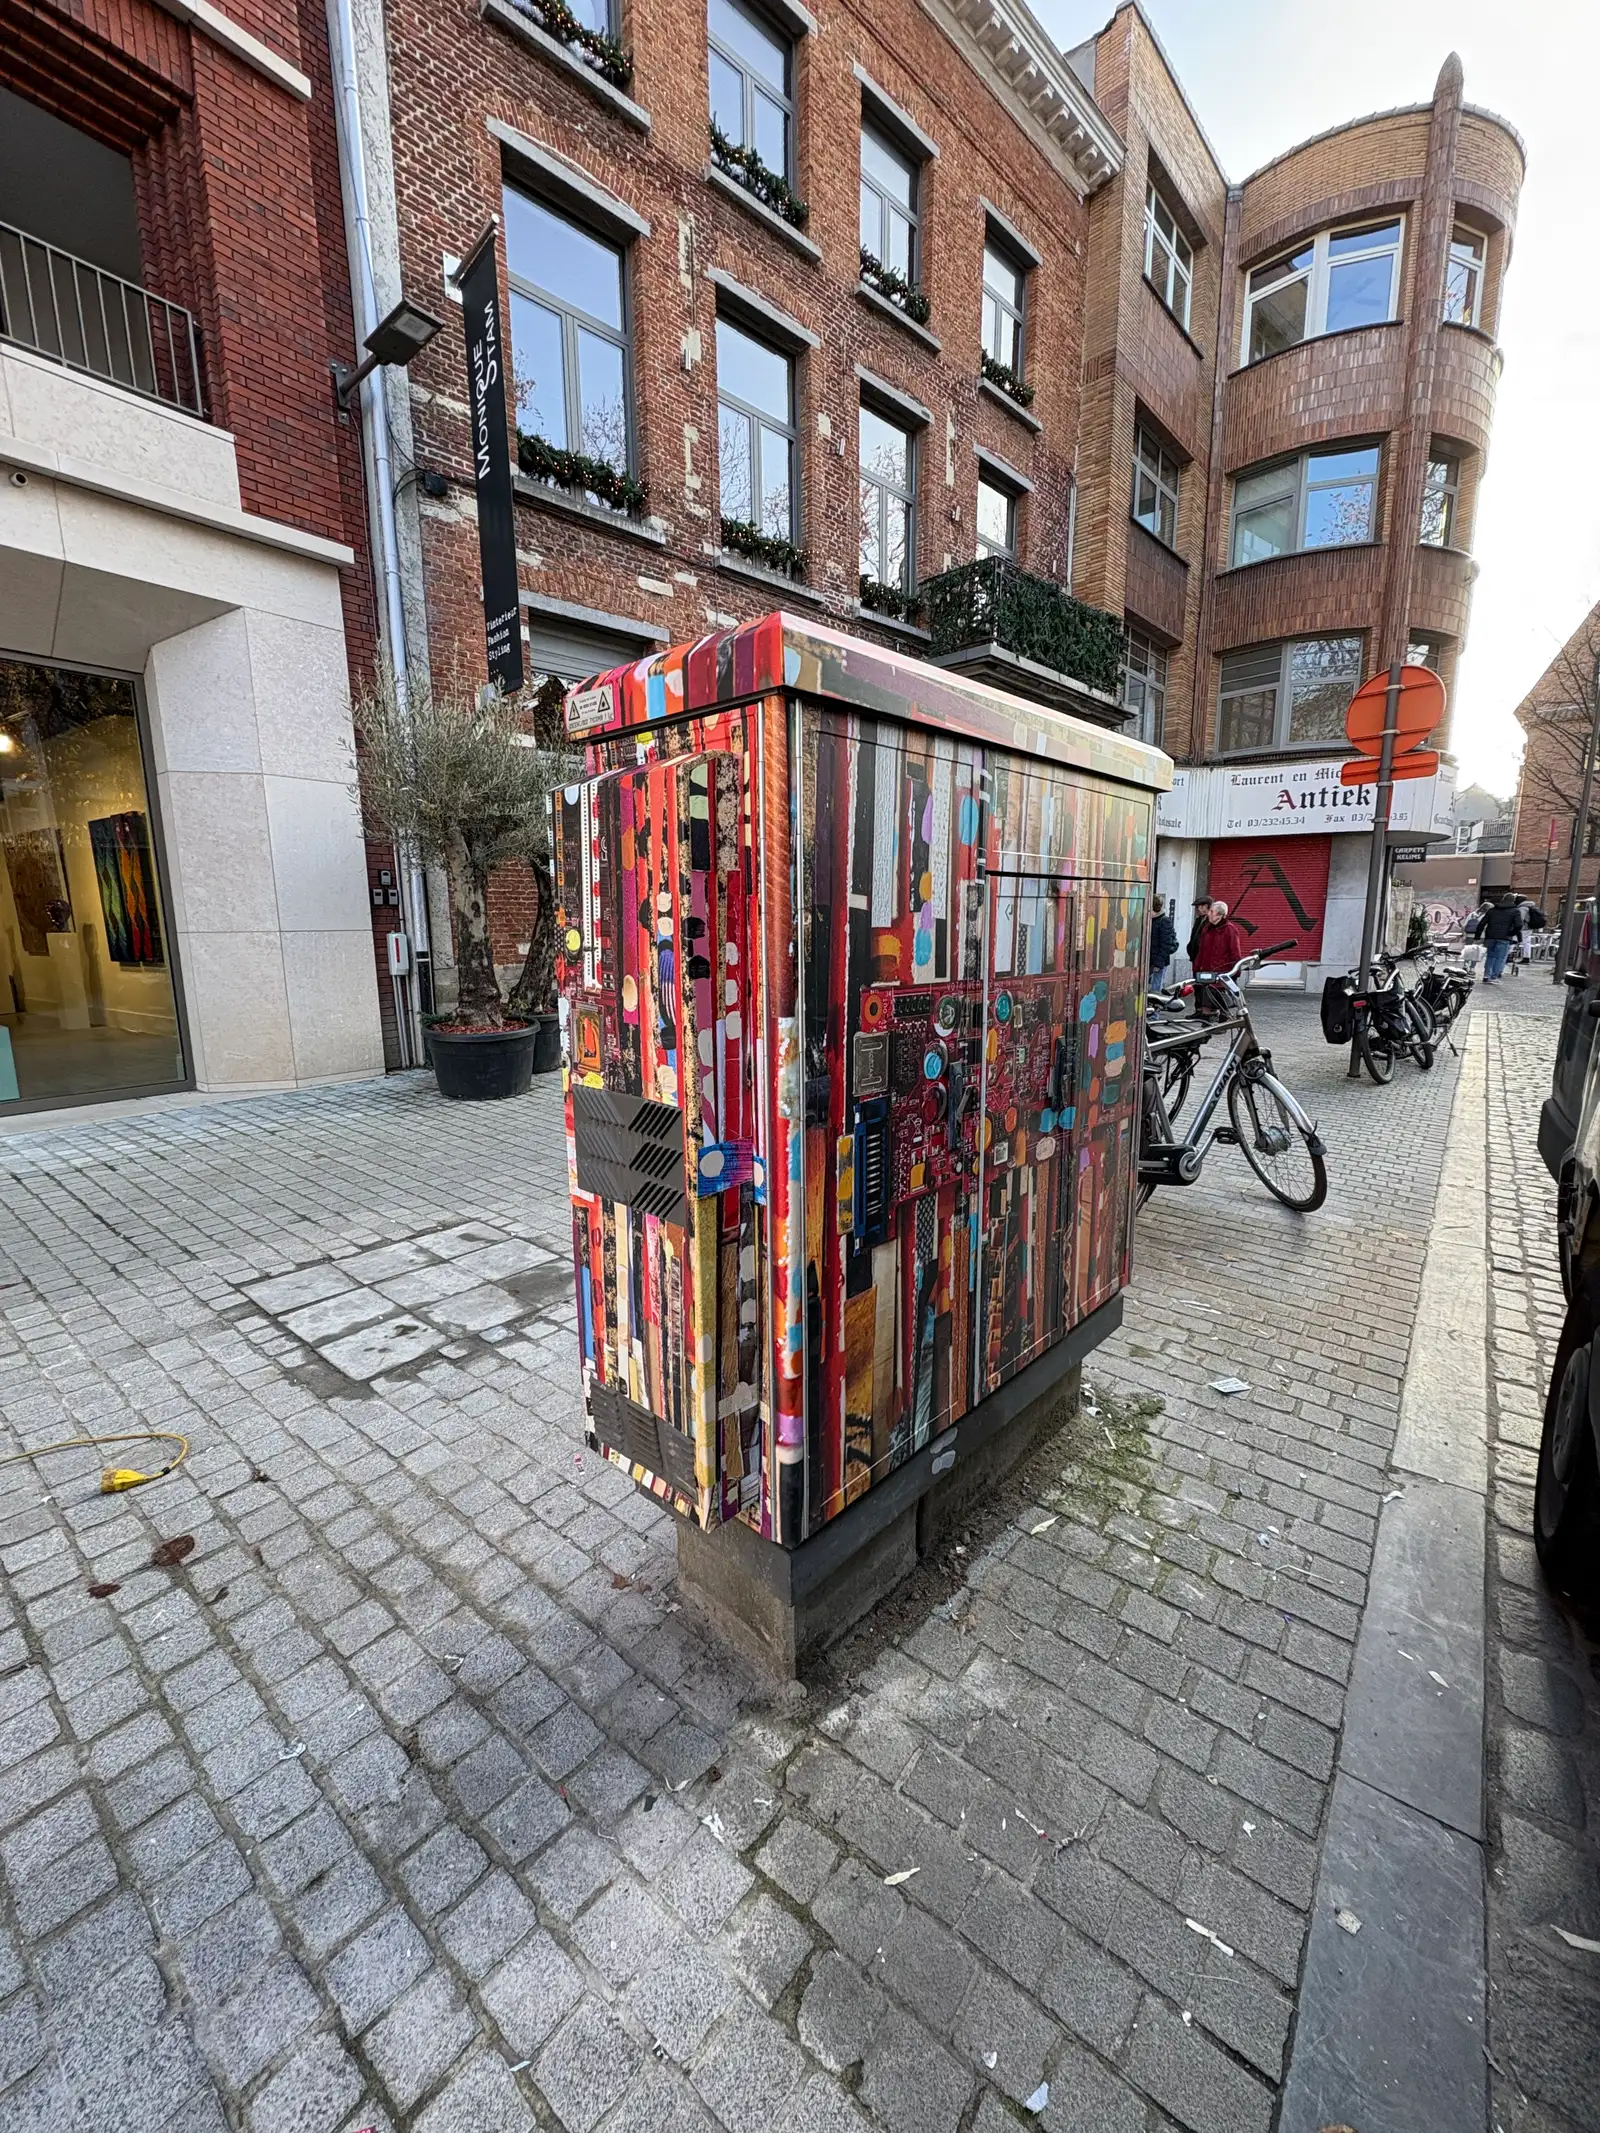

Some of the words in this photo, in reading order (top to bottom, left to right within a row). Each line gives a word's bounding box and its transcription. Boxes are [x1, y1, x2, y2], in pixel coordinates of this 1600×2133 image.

[487, 628, 510, 647] Fashion
[488, 643, 511, 661] Styling
[1231, 773, 1284, 786] Laurent
[1293, 773, 1307, 782] en
[1271, 784, 1371, 811] Antiek
[1227, 819, 1242, 829] Tel
[1324, 815, 1345, 823] Fax
[1228, 853, 1319, 936] A
[1214, 1055, 1238, 1098] GIANT
